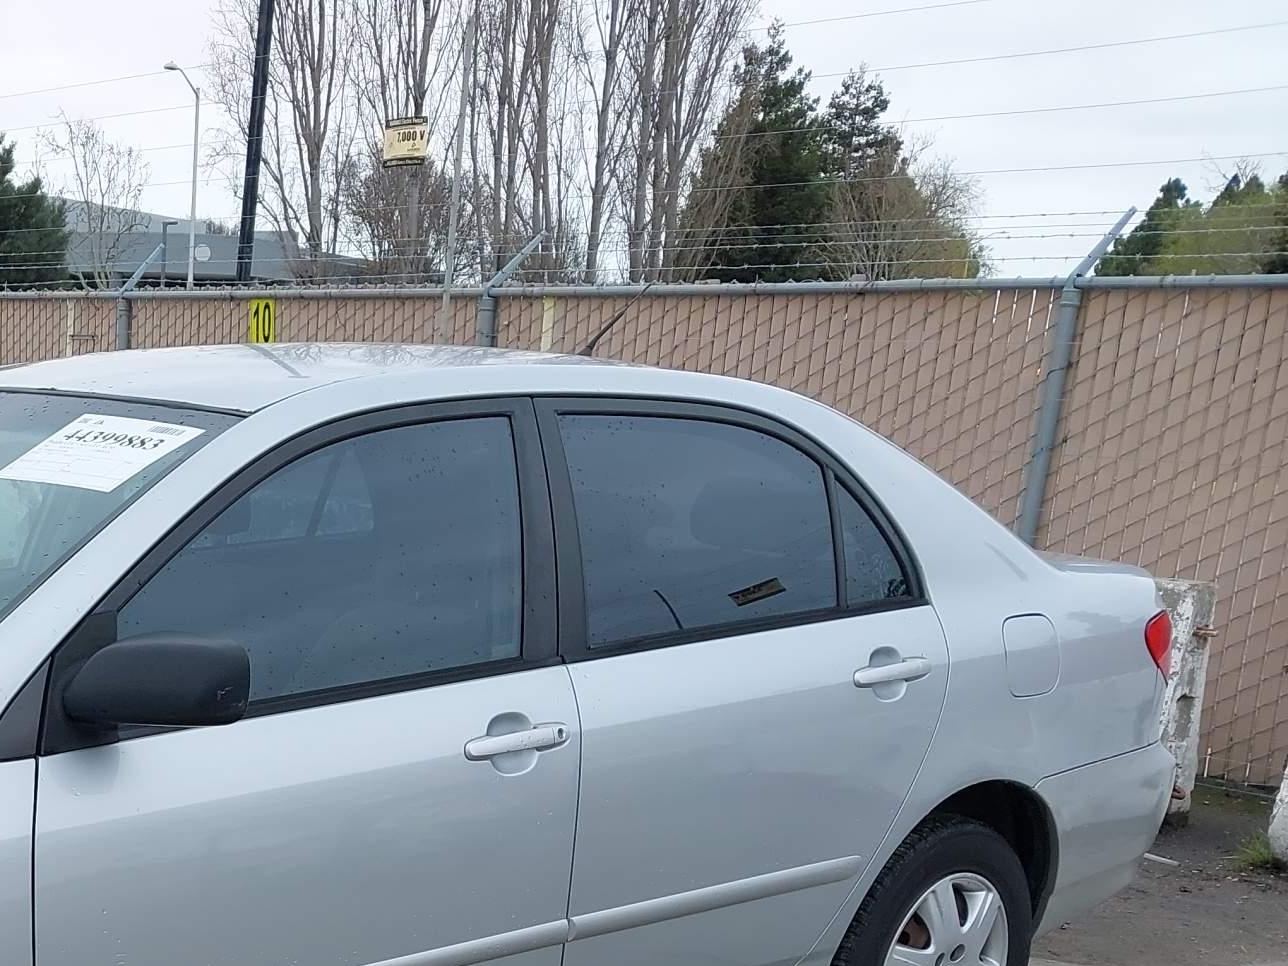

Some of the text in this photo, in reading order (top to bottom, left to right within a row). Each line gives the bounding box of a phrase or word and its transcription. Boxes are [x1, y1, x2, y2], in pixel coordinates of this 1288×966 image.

[397, 130, 425, 143] 7,000 V
[253, 302, 271, 343] 10
[64, 429, 165, 450] 44399883
